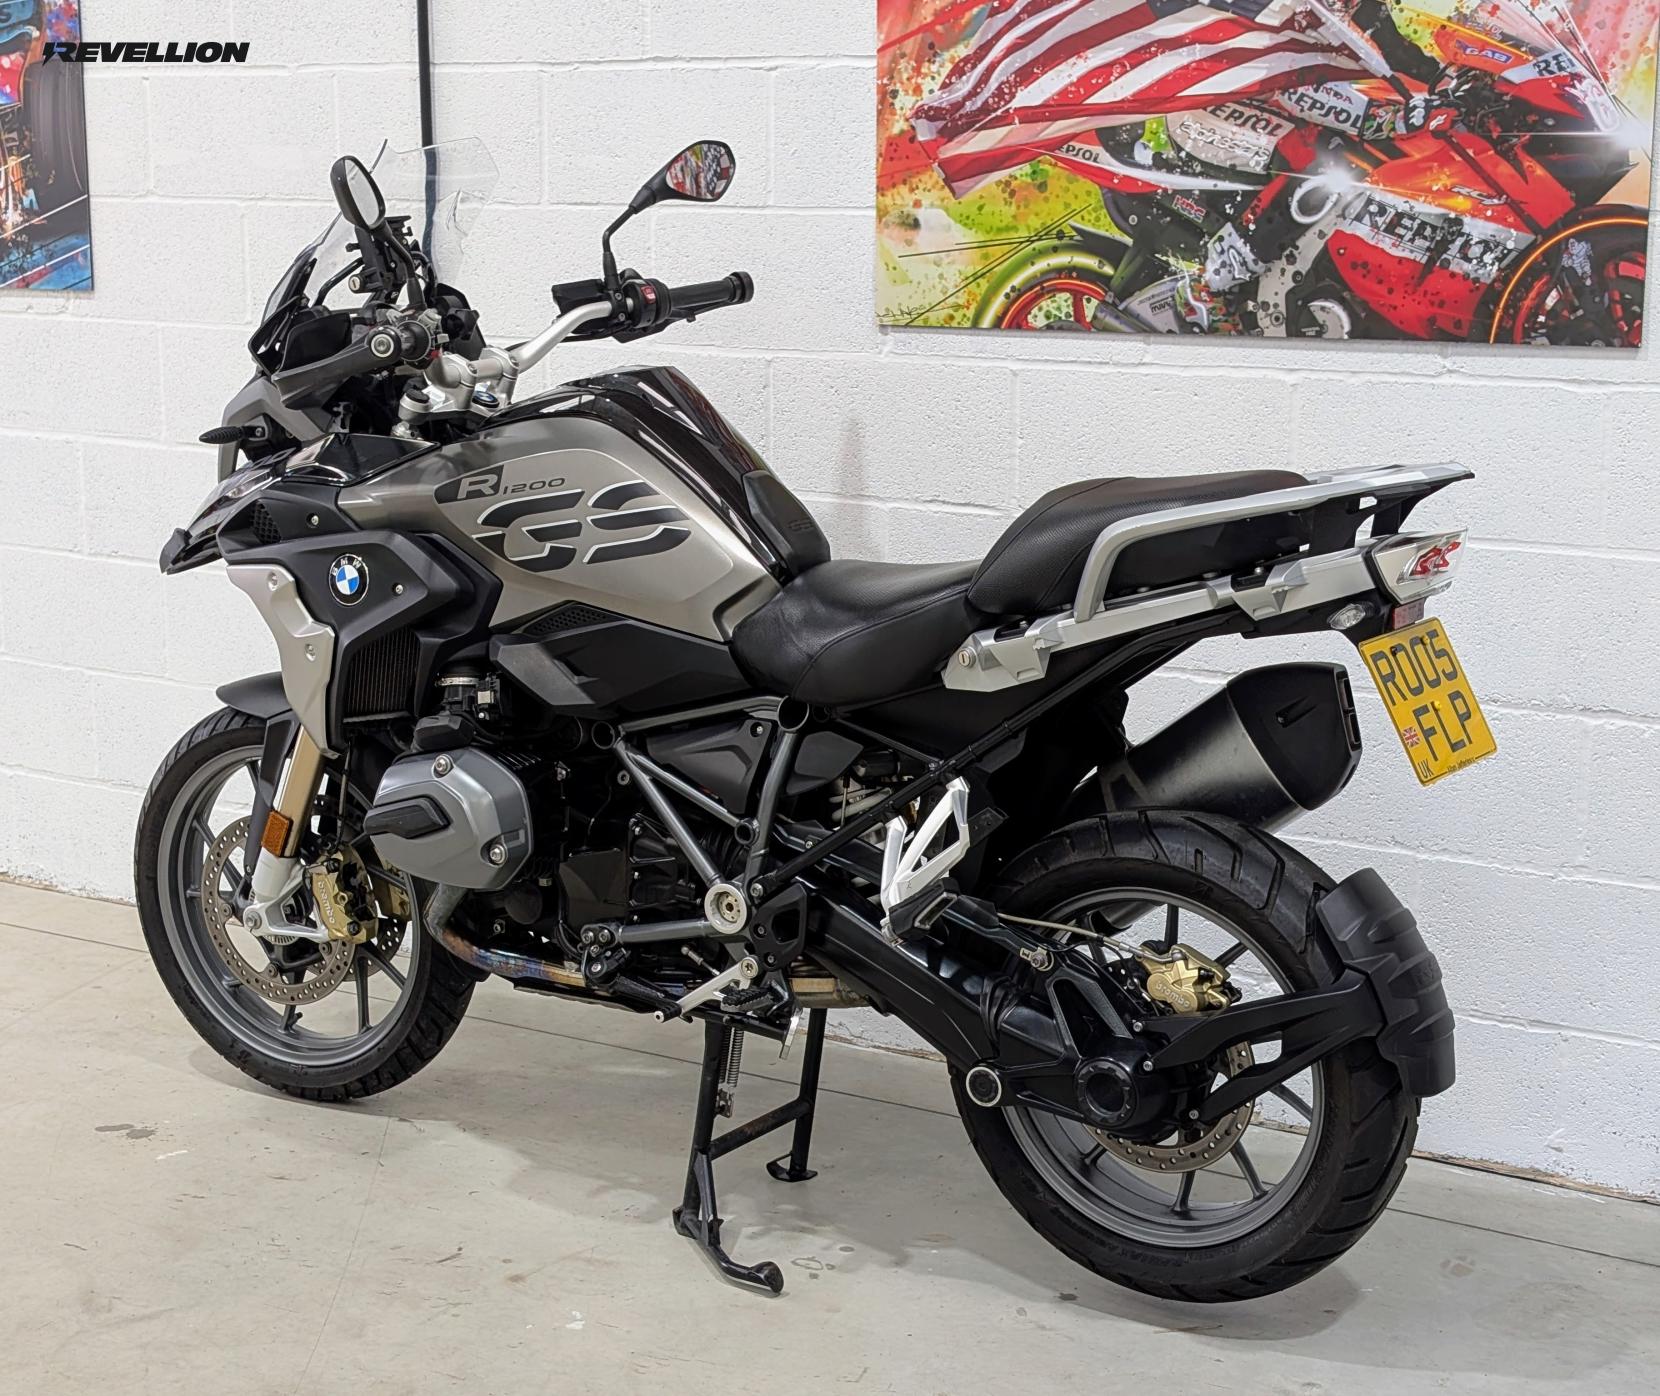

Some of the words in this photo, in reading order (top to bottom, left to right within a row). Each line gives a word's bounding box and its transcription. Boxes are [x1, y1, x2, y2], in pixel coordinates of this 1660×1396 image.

[1203, 103, 1284, 137] EPSOL
[456, 474, 499, 500] R
[502, 477, 566, 496] 1200
[471, 479, 692, 573] GS
[331, 556, 362, 576] BMW
[1413, 690, 1473, 762] FLP
[1417, 759, 1434, 780] UK
[1155, 980, 1192, 1010] brembo
